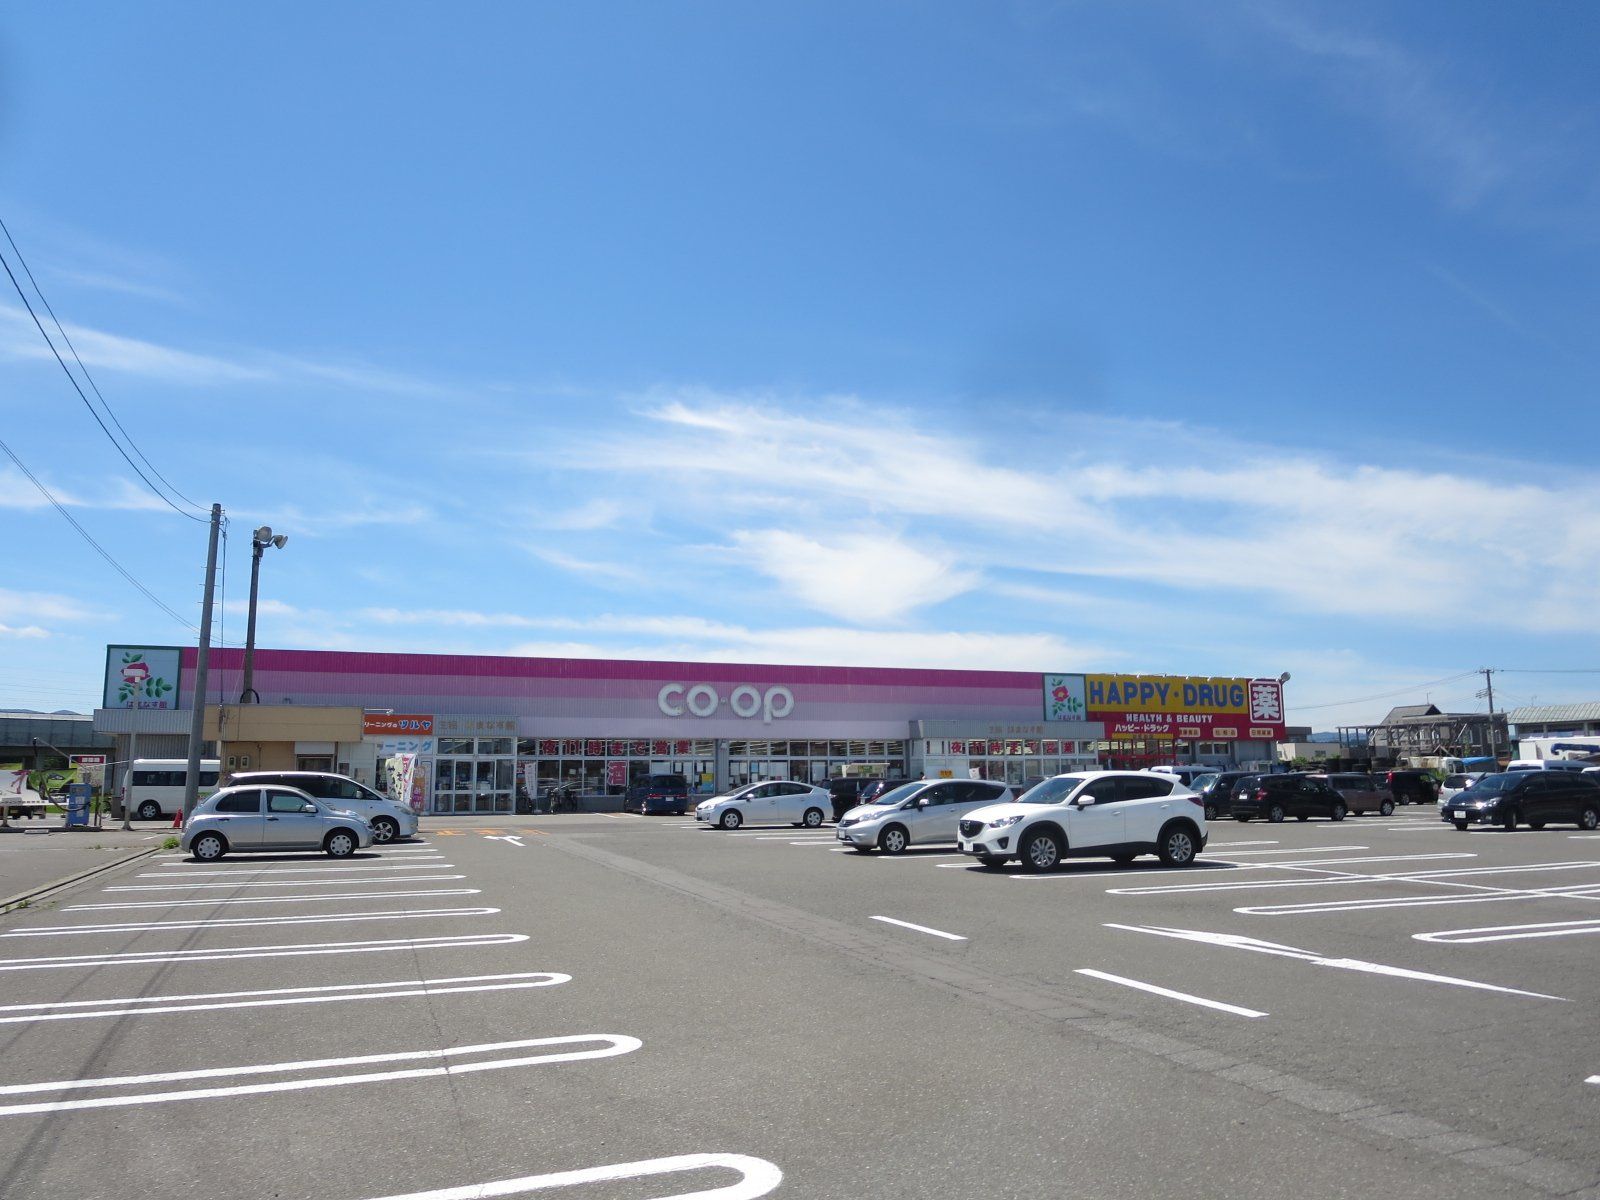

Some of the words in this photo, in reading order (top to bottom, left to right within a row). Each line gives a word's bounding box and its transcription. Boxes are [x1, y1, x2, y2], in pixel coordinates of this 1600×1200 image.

[1252, 685, 1281, 720] 薬
[1126, 713, 1162, 723] HEALTH
[1166, 714, 1173, 723] &
[1176, 714, 1213, 724] BEAUTY
